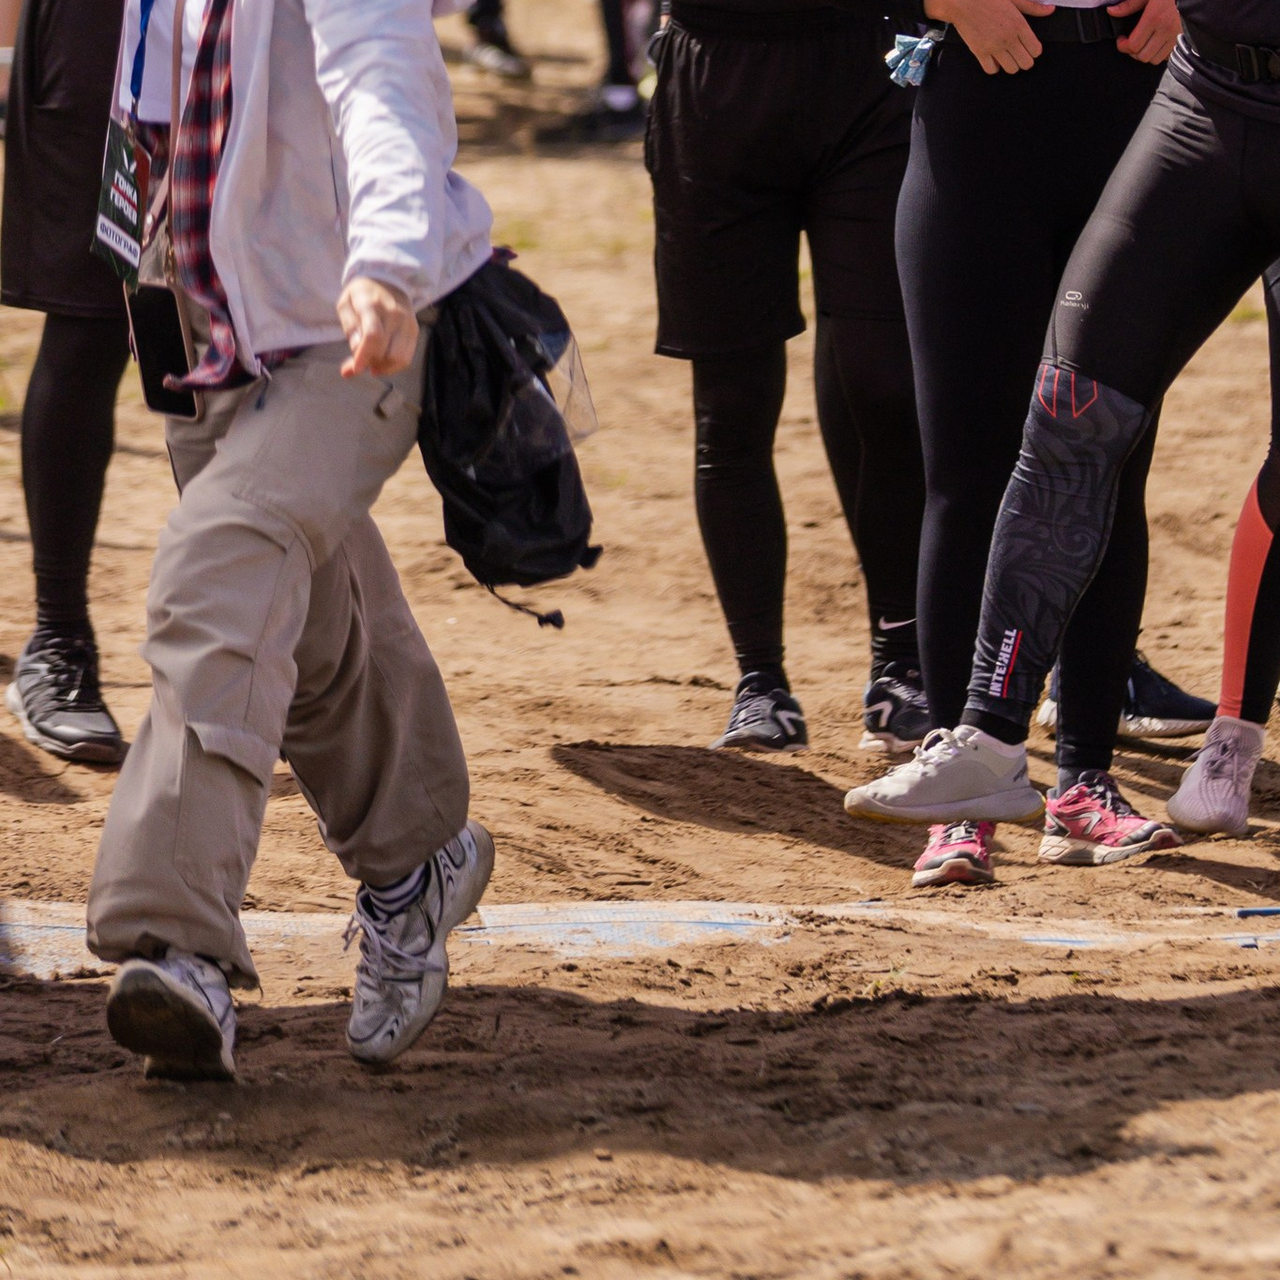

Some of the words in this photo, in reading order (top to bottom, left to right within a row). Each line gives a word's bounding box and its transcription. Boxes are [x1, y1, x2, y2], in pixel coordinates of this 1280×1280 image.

[114, 170, 138, 203] ГОНКА
[110, 186, 138, 226] ГЕРОЕВ
[100, 222, 139, 259] ФОТОГРАФ
